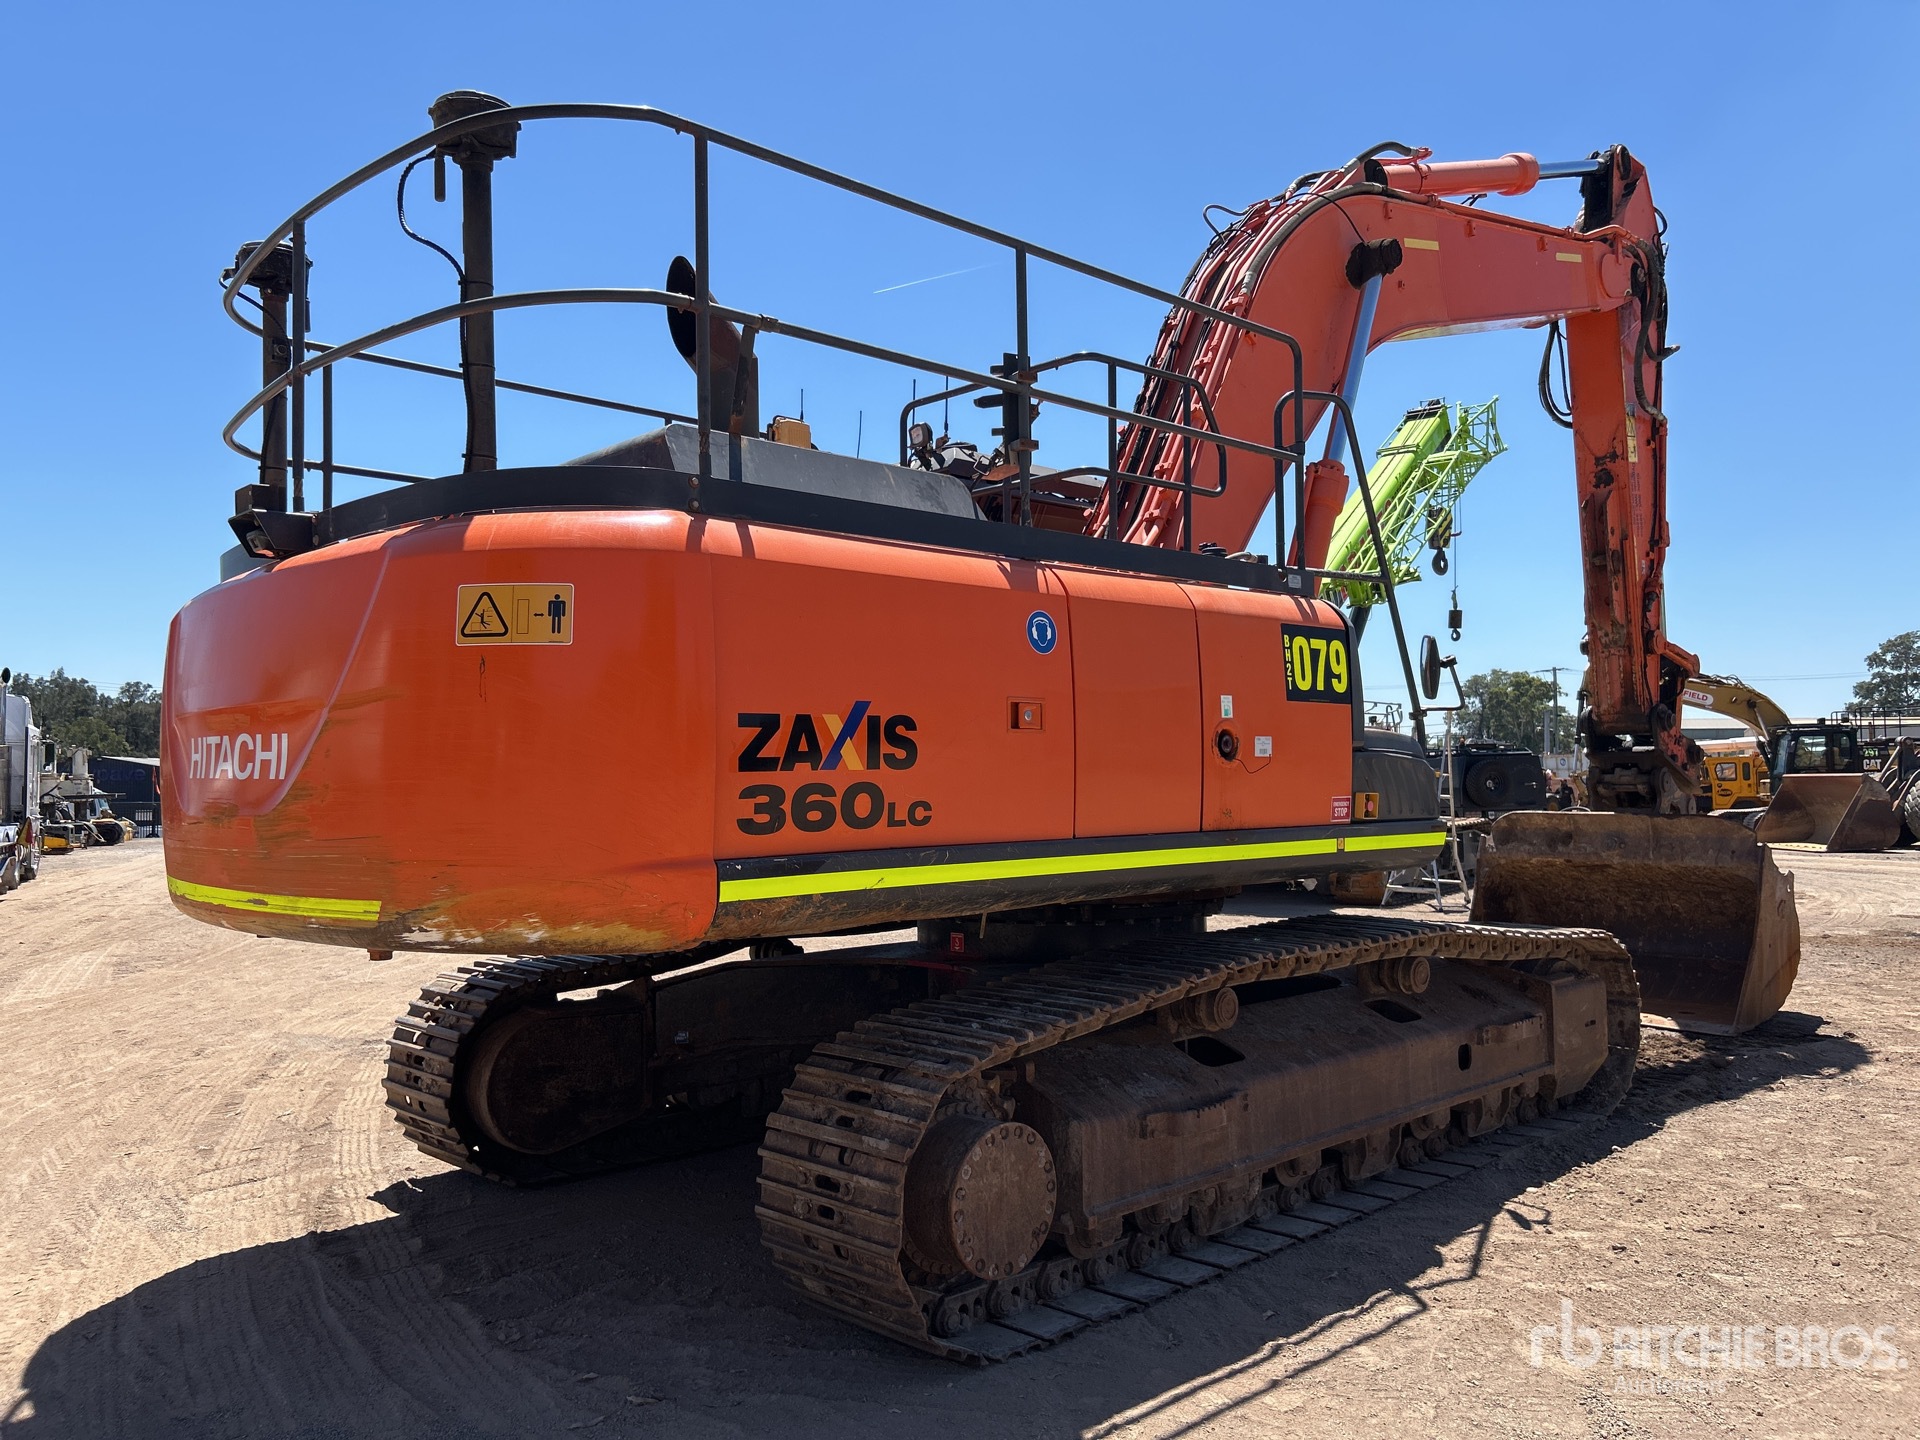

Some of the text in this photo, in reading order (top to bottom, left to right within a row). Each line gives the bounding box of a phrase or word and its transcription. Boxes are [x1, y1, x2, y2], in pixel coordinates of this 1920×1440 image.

[1292, 636, 1348, 693] 079
[189, 733, 288, 780] HITACHI
[738, 700, 918, 772] ZAXIS
[1863, 759, 1882, 770] CAT
[1334, 807, 1348, 817] STOP
